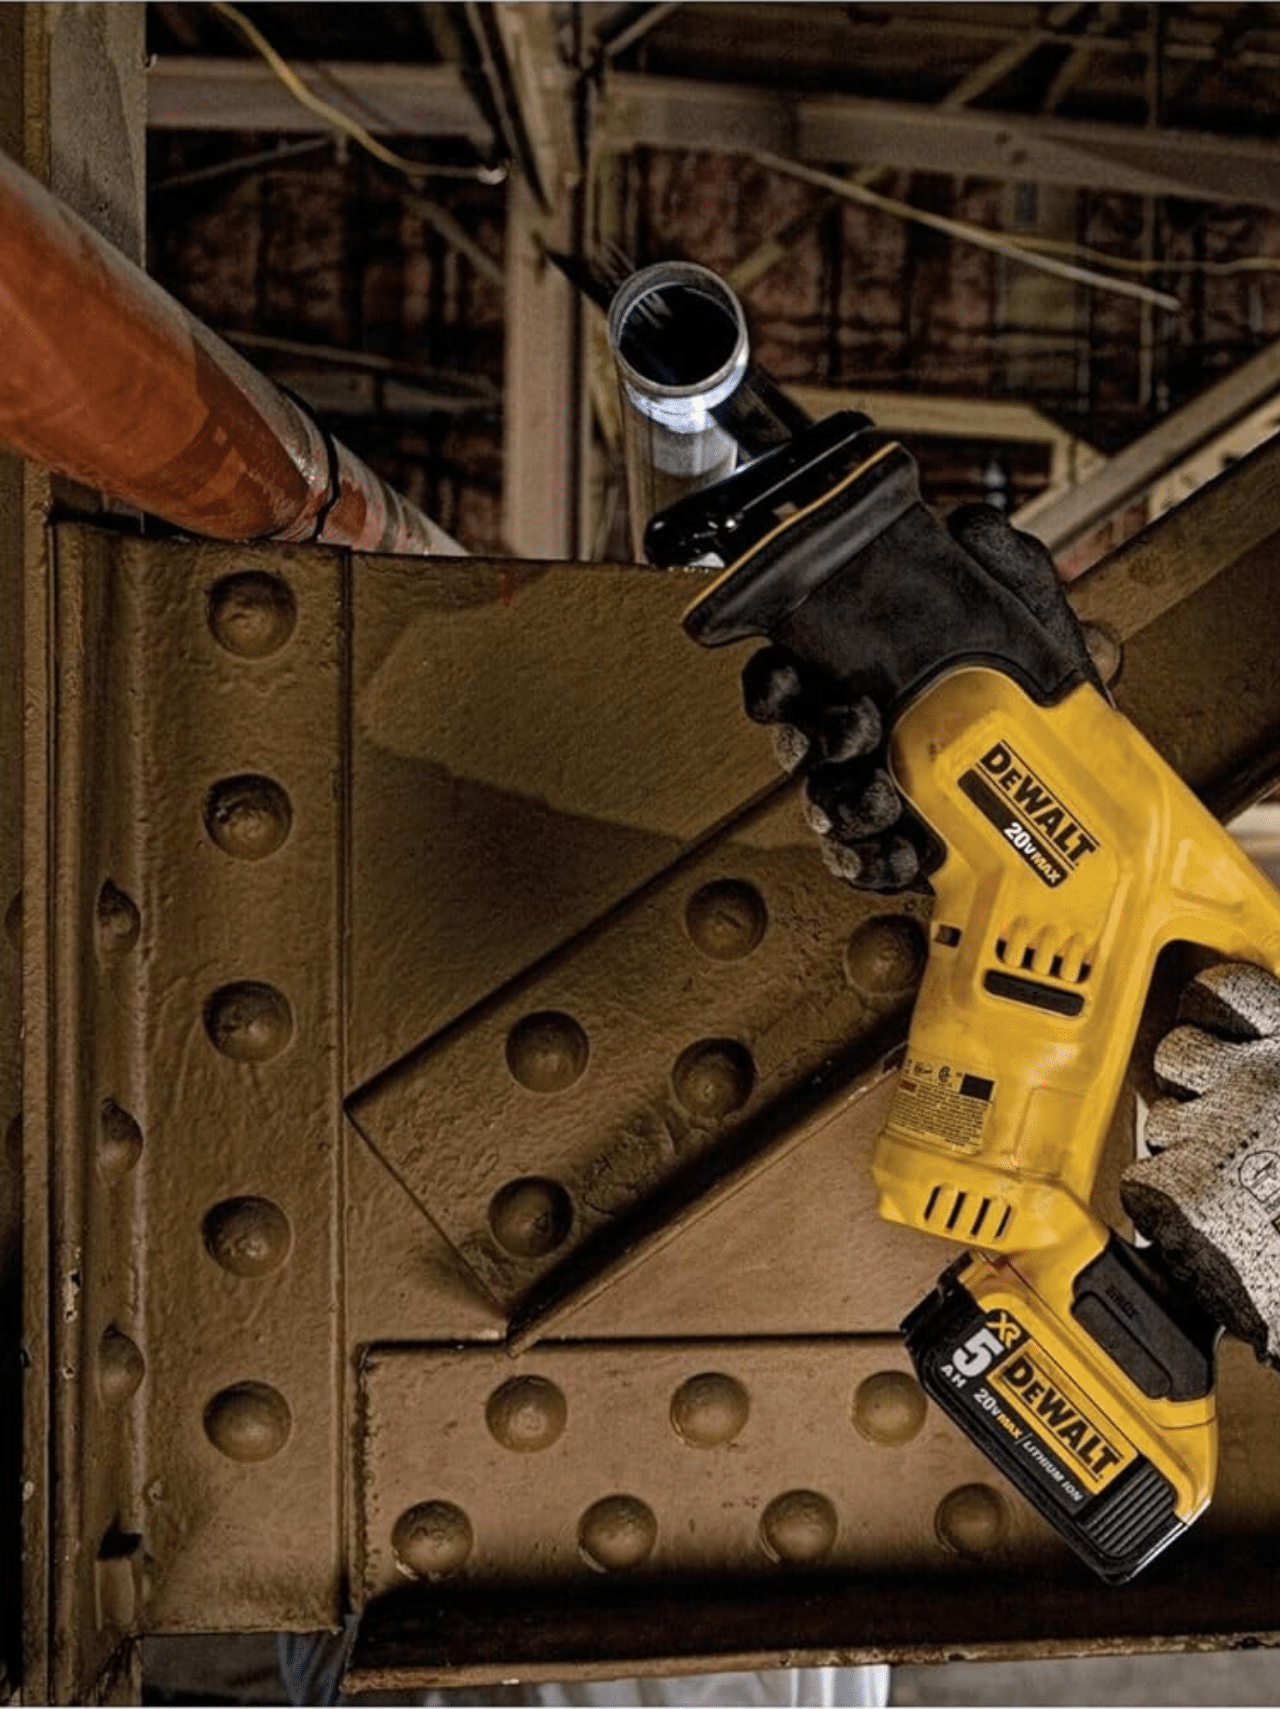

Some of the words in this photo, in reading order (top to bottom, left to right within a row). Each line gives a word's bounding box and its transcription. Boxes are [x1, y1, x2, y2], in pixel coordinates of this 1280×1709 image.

[952, 1327, 1005, 1377] 5
[985, 1312, 1021, 1349] XR
[1022, 1440, 1066, 1482] LITHIUM
[1061, 1481, 1084, 1502] ION
